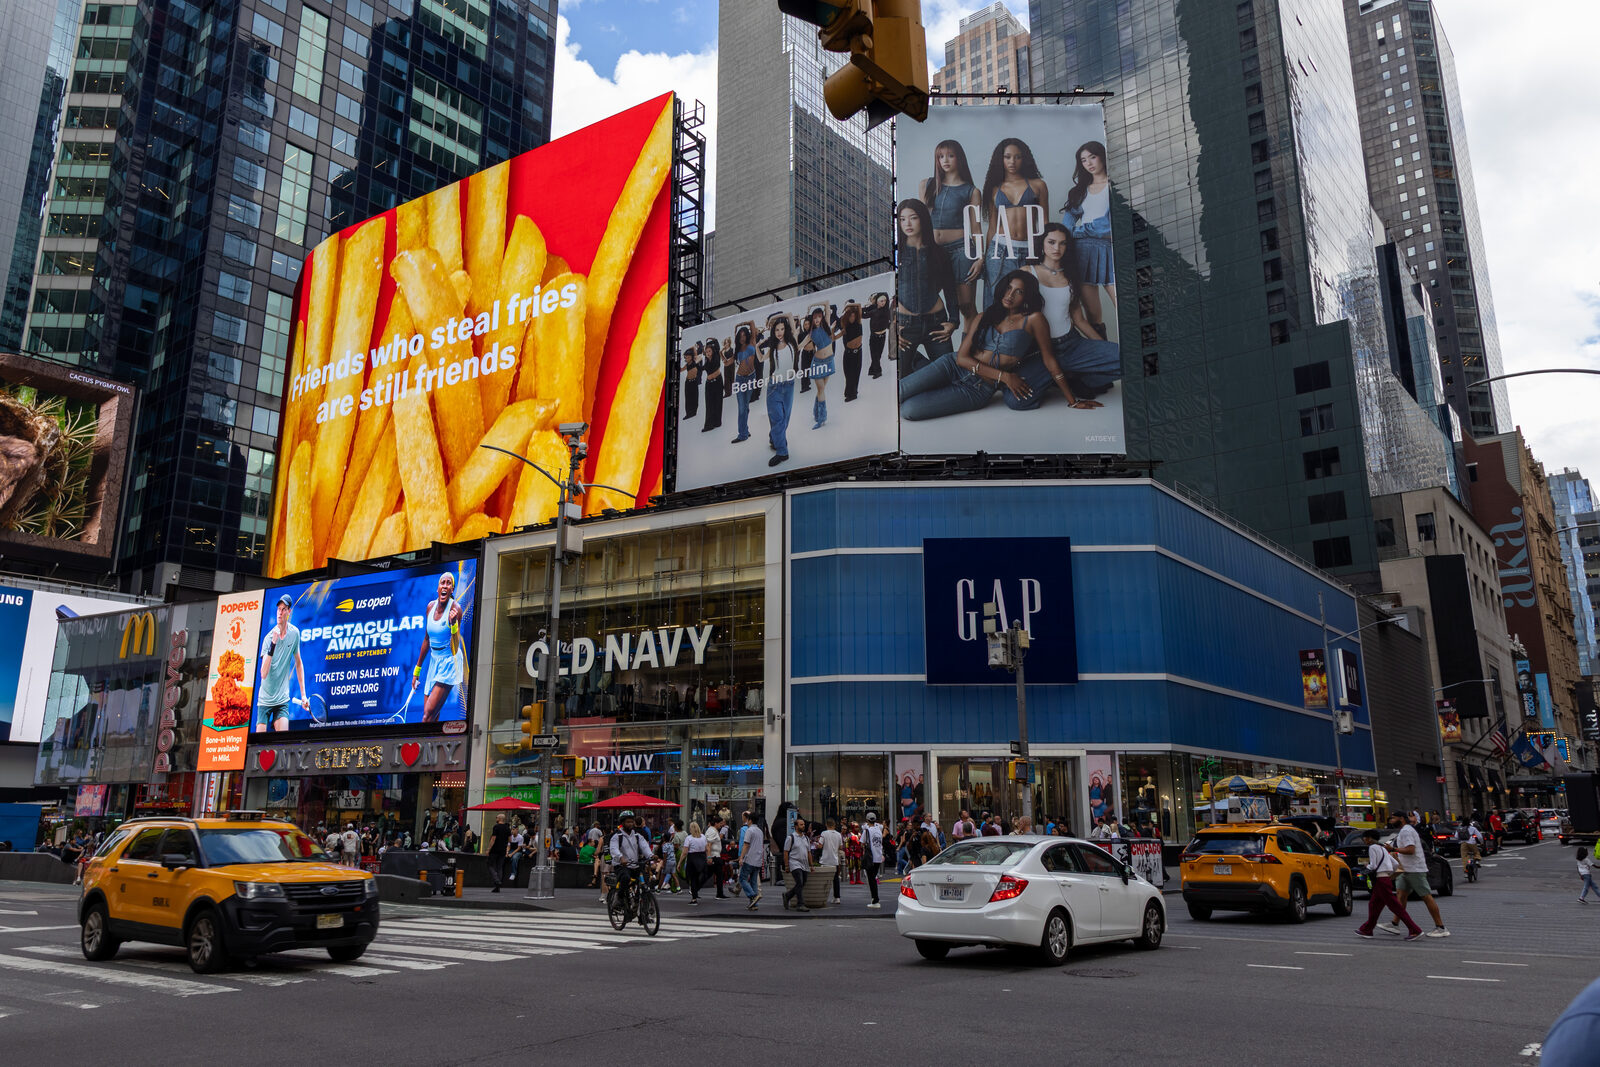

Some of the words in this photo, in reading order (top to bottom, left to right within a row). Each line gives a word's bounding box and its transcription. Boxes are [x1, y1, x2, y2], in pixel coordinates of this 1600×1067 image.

[963, 204, 1045, 260] GAP
[292, 350, 364, 402] Friends
[370, 333, 425, 369] who
[430, 300, 500, 350] steal
[506, 283, 578, 326] fries
[69, 372, 94, 385] CACTUS
[95, 379, 116, 391] PYGMY
[117, 384, 131, 394] OWL
[316, 395, 354, 425] are
[359, 368, 409, 411] still
[414, 342, 516, 395] friends
[731, 376, 769, 395] Better
[771, 372, 784, 385] in
[786, 363, 832, 381] Denim.
[368, 595, 391, 611] open
[956, 578, 1042, 642] GAP
[300, 615, 424, 642] SPECTACULAR
[326, 632, 392, 652] AWAITS
[604, 624, 714, 672] NAVY
[325, 652, 345, 661] AUGUST
[356, 648, 386, 658] SEPTEMBER
[315, 671, 344, 683] TICKETS
[346, 670, 358, 680] ON
[360, 668, 379, 678] SALE
[381, 666, 400, 677] NOW
[331, 683, 379, 696] USOPEN.ORG
[205, 736, 225, 745] Bone-in
[226, 736, 242, 744] Wings
[217, 745, 240, 753] available
[218, 754, 231, 762] Mild.
[277, 748, 311, 771] NY
[314, 745, 384, 769] GIFTS
[421, 740, 462, 766] NY
[610, 754, 654, 771] NAVY
[344, 797, 361, 807] NY
[1130, 842, 1161, 856] CHICAGO
